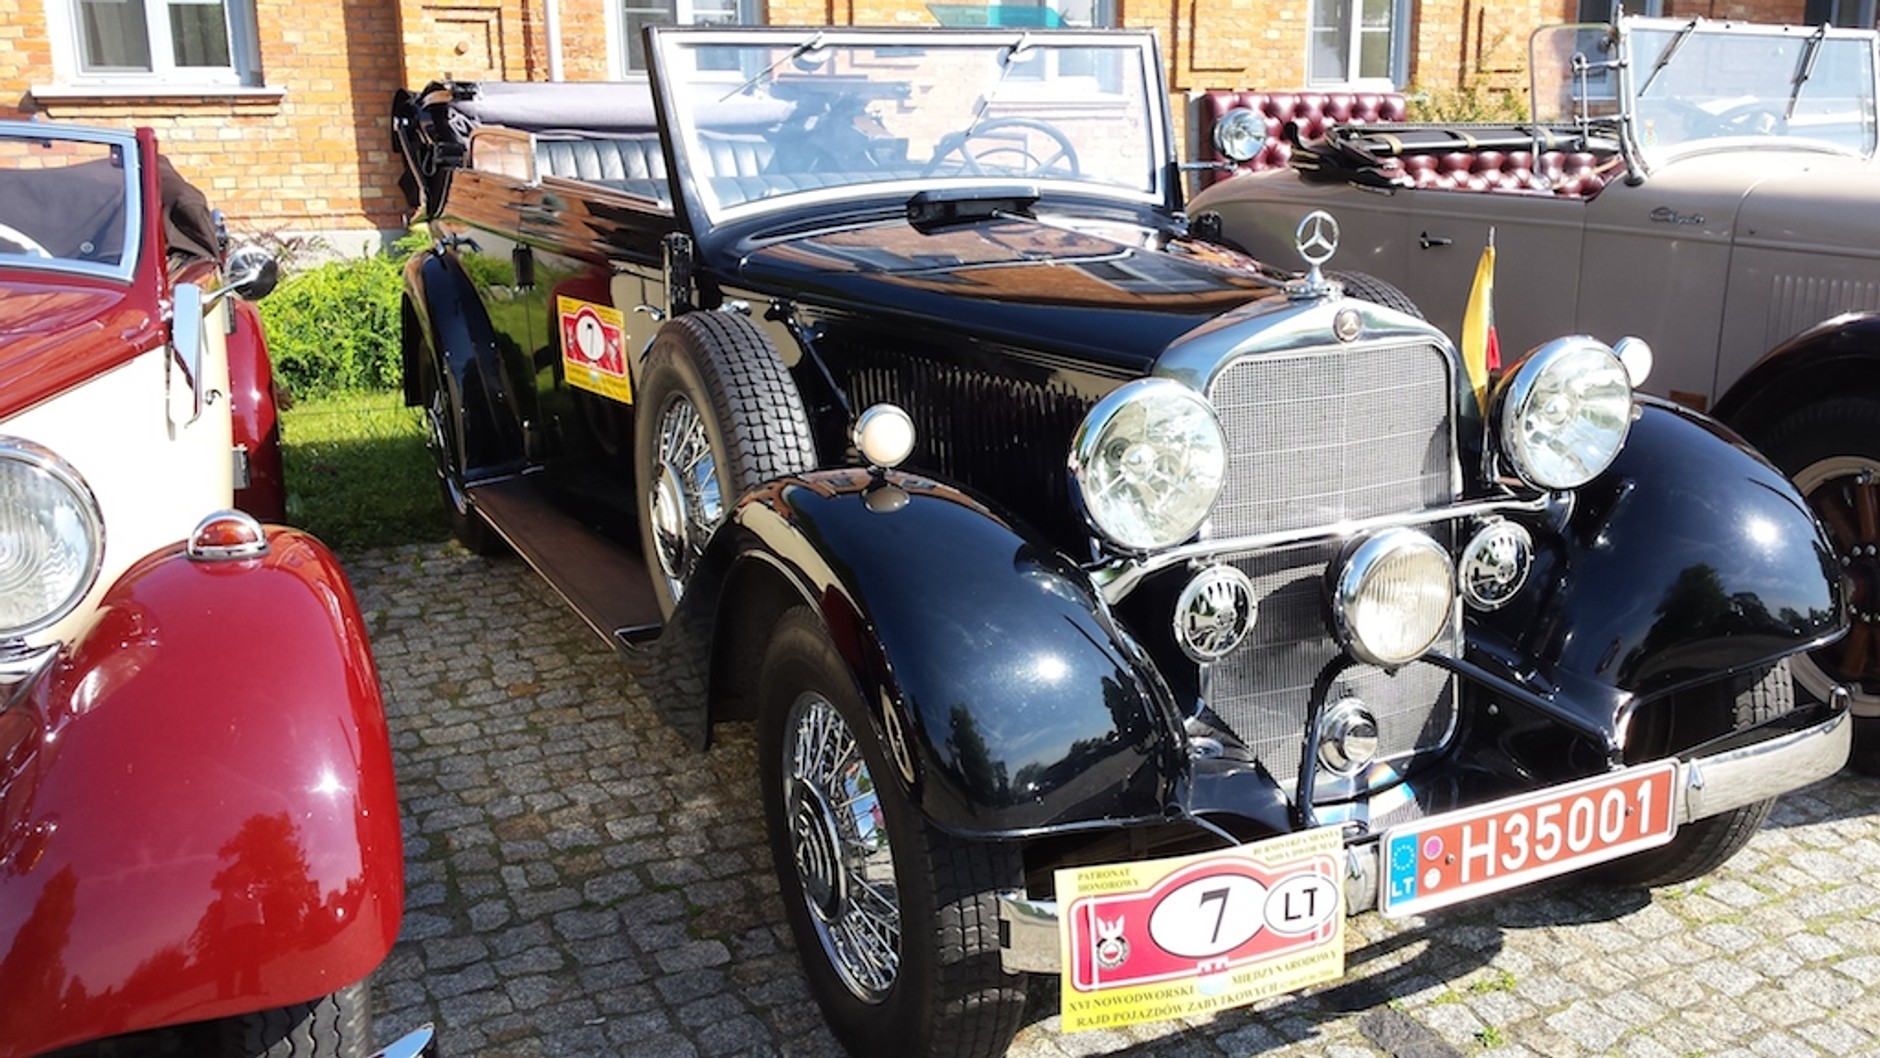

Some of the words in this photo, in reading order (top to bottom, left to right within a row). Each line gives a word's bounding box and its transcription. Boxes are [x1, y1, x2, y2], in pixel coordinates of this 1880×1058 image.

[1461, 780, 1653, 883] H35001
[1077, 868, 1130, 880] PATRONAT
[1078, 879, 1139, 892] HONOROWY
[1391, 876, 1415, 897] LT
[1199, 887, 1231, 943] 7
[1284, 888, 1318, 921] LT
[1069, 1000, 1091, 1012] XVI
[1093, 985, 1194, 1007] NOWODWORSKI
[1077, 1013, 1110, 1027] RAJD
[1113, 1004, 1182, 1022] POJAZDÓW
[1187, 982, 1278, 1012] ZABYTKOWYCH
